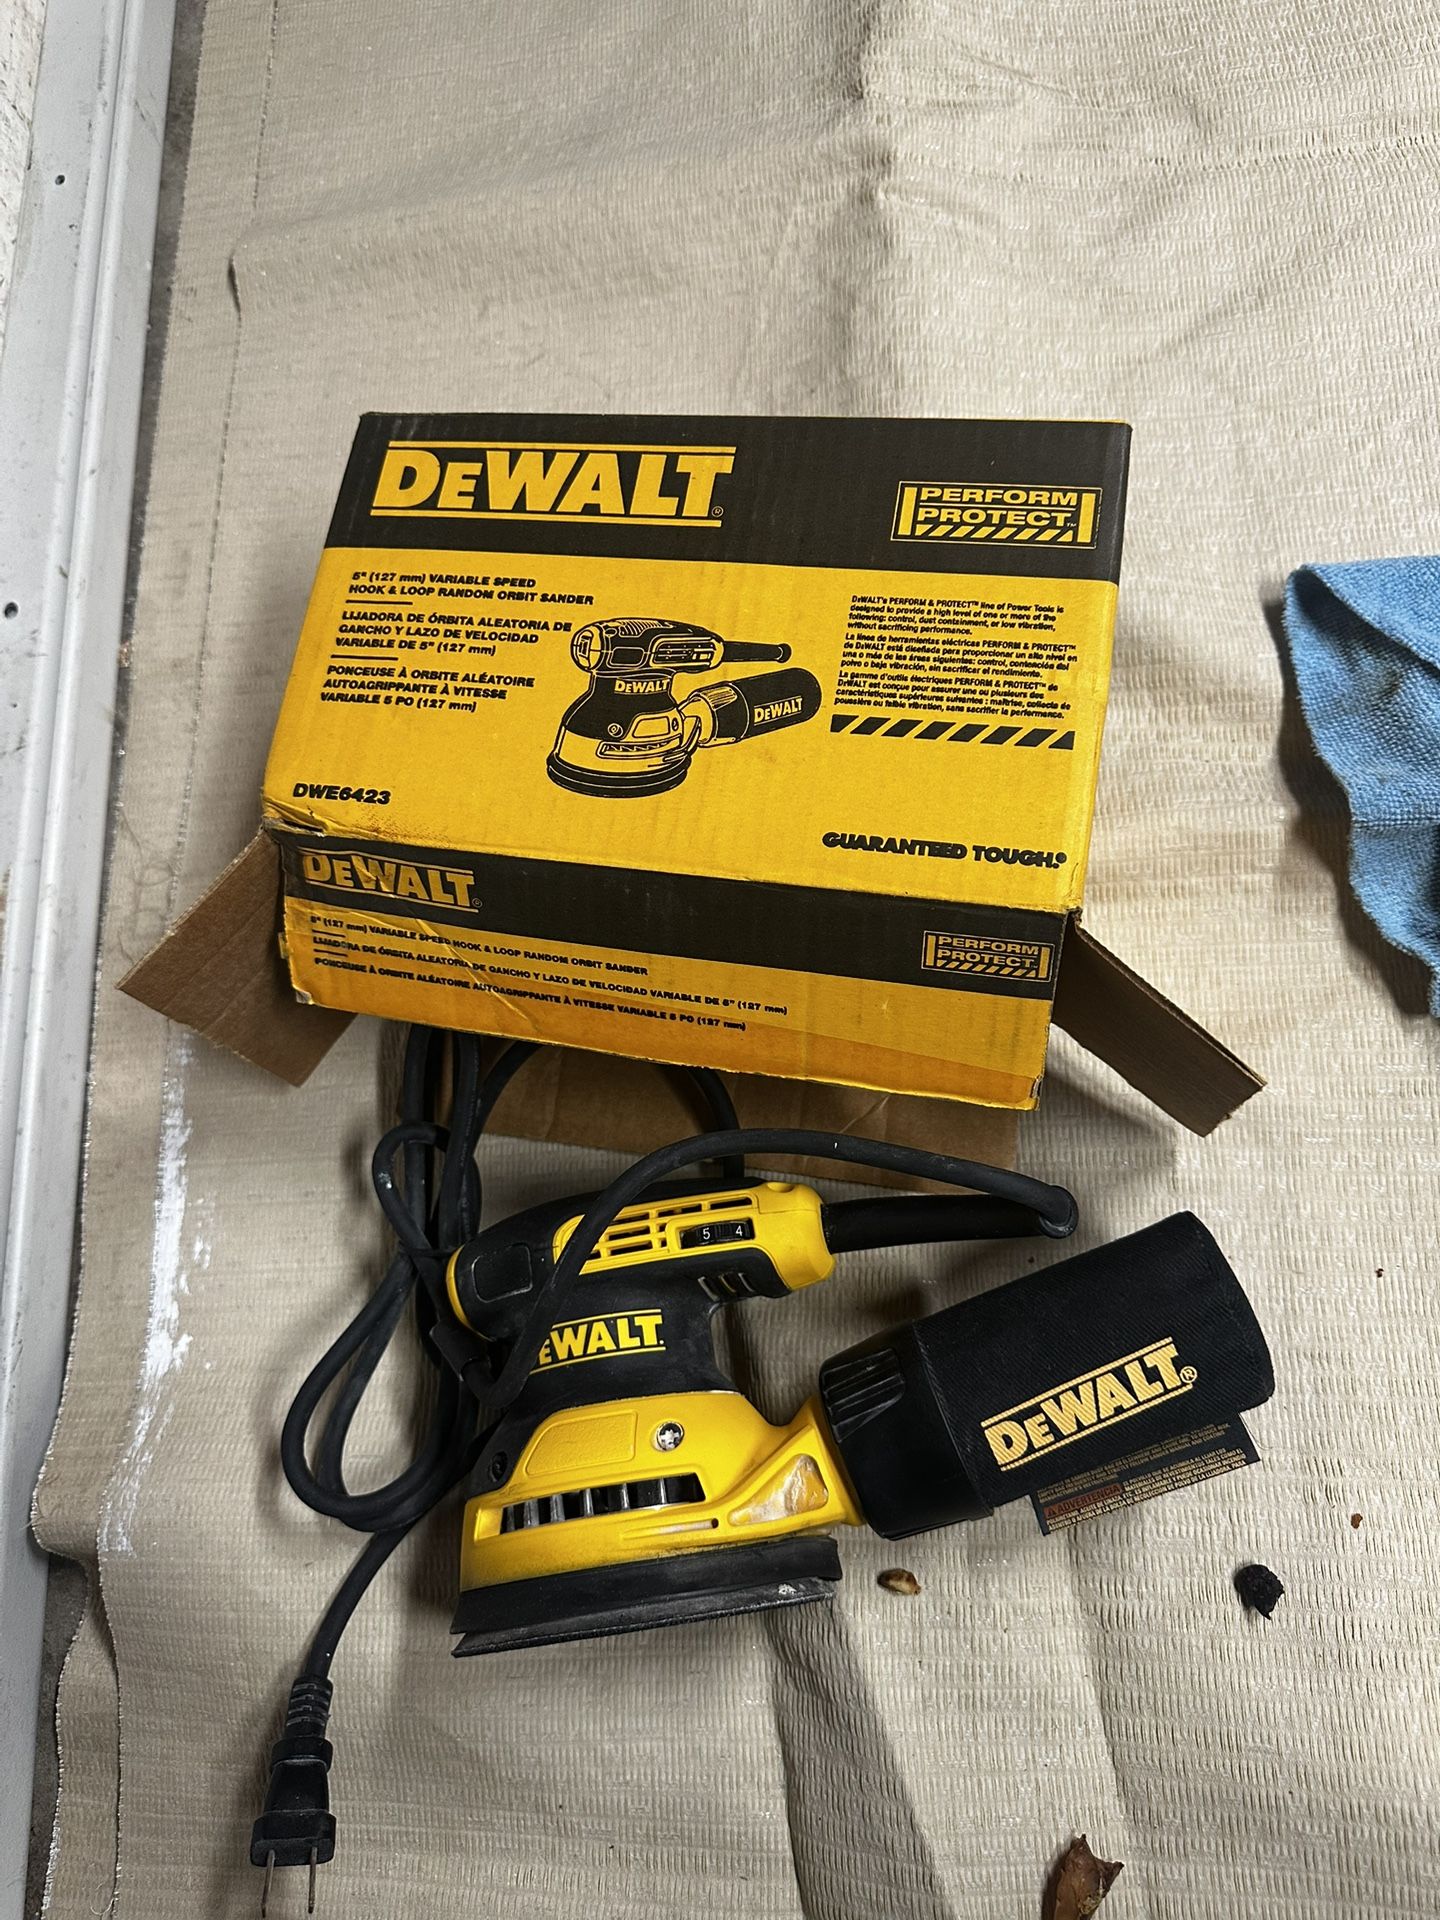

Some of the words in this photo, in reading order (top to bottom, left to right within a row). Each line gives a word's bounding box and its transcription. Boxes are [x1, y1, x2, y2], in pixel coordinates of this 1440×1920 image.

[921, 487, 1077, 505] PERFORM
[351, 571, 366, 580] 5"
[368, 572, 396, 582] (127
[398, 573, 425, 584] mm)
[429, 573, 490, 585] VARIABLE
[492, 577, 535, 587] SPEED
[348, 584, 385, 594] HOOK
[387, 585, 396, 594] &
[399, 585, 435, 595] LOOP
[437, 587, 494, 598] RANDOM
[497, 590, 537, 601] ORBIT
[539, 592, 593, 604] SANDER
[341, 610, 403, 621] LIJADORA
[406, 613, 425, 622] DE
[427, 613, 474, 625] ÓRBITA
[477, 617, 549, 630] ALEATORIA
[552, 621, 572, 631] DE
[338, 624, 391, 634] GANCHO
[395, 626, 404, 635] Y
[405, 626, 439, 637] LAZO
[443, 628, 461, 638] DE
[465, 630, 538, 643] VELOCIDAD
[335, 637, 395, 648] VARIABLE
[397, 639, 416, 649] DE
[418, 641, 434, 650] 5"
[436, 641, 465, 652] (127
[468, 645, 495, 656] mm)
[326, 665, 395, 676] PONCEUSE
[397, 666, 406, 678] À
[410, 669, 459, 681] ORBITE
[460, 672, 534, 687] ALÉATOIRE
[322, 678, 437, 693] AUTOAGRIPPANTE
[439, 683, 449, 695] À
[453, 686, 507, 699] VITESSE
[615, 680, 669, 693] DEWALT
[320, 692, 380, 703] VARIABLE
[383, 695, 392, 704] 5
[394, 696, 414, 706] PO
[416, 697, 445, 708] (127
[448, 701, 476, 712] mm)
[754, 698, 802, 722] DEWALT
[293, 783, 391, 804] DWE6423
[822, 832, 967, 859] GUARANTEED
[938, 936, 1039, 955] PERFORM
[702, 1228, 710, 1240] 5
[735, 1226, 743, 1237] 4
[538, 1314, 662, 1364] EWALT
